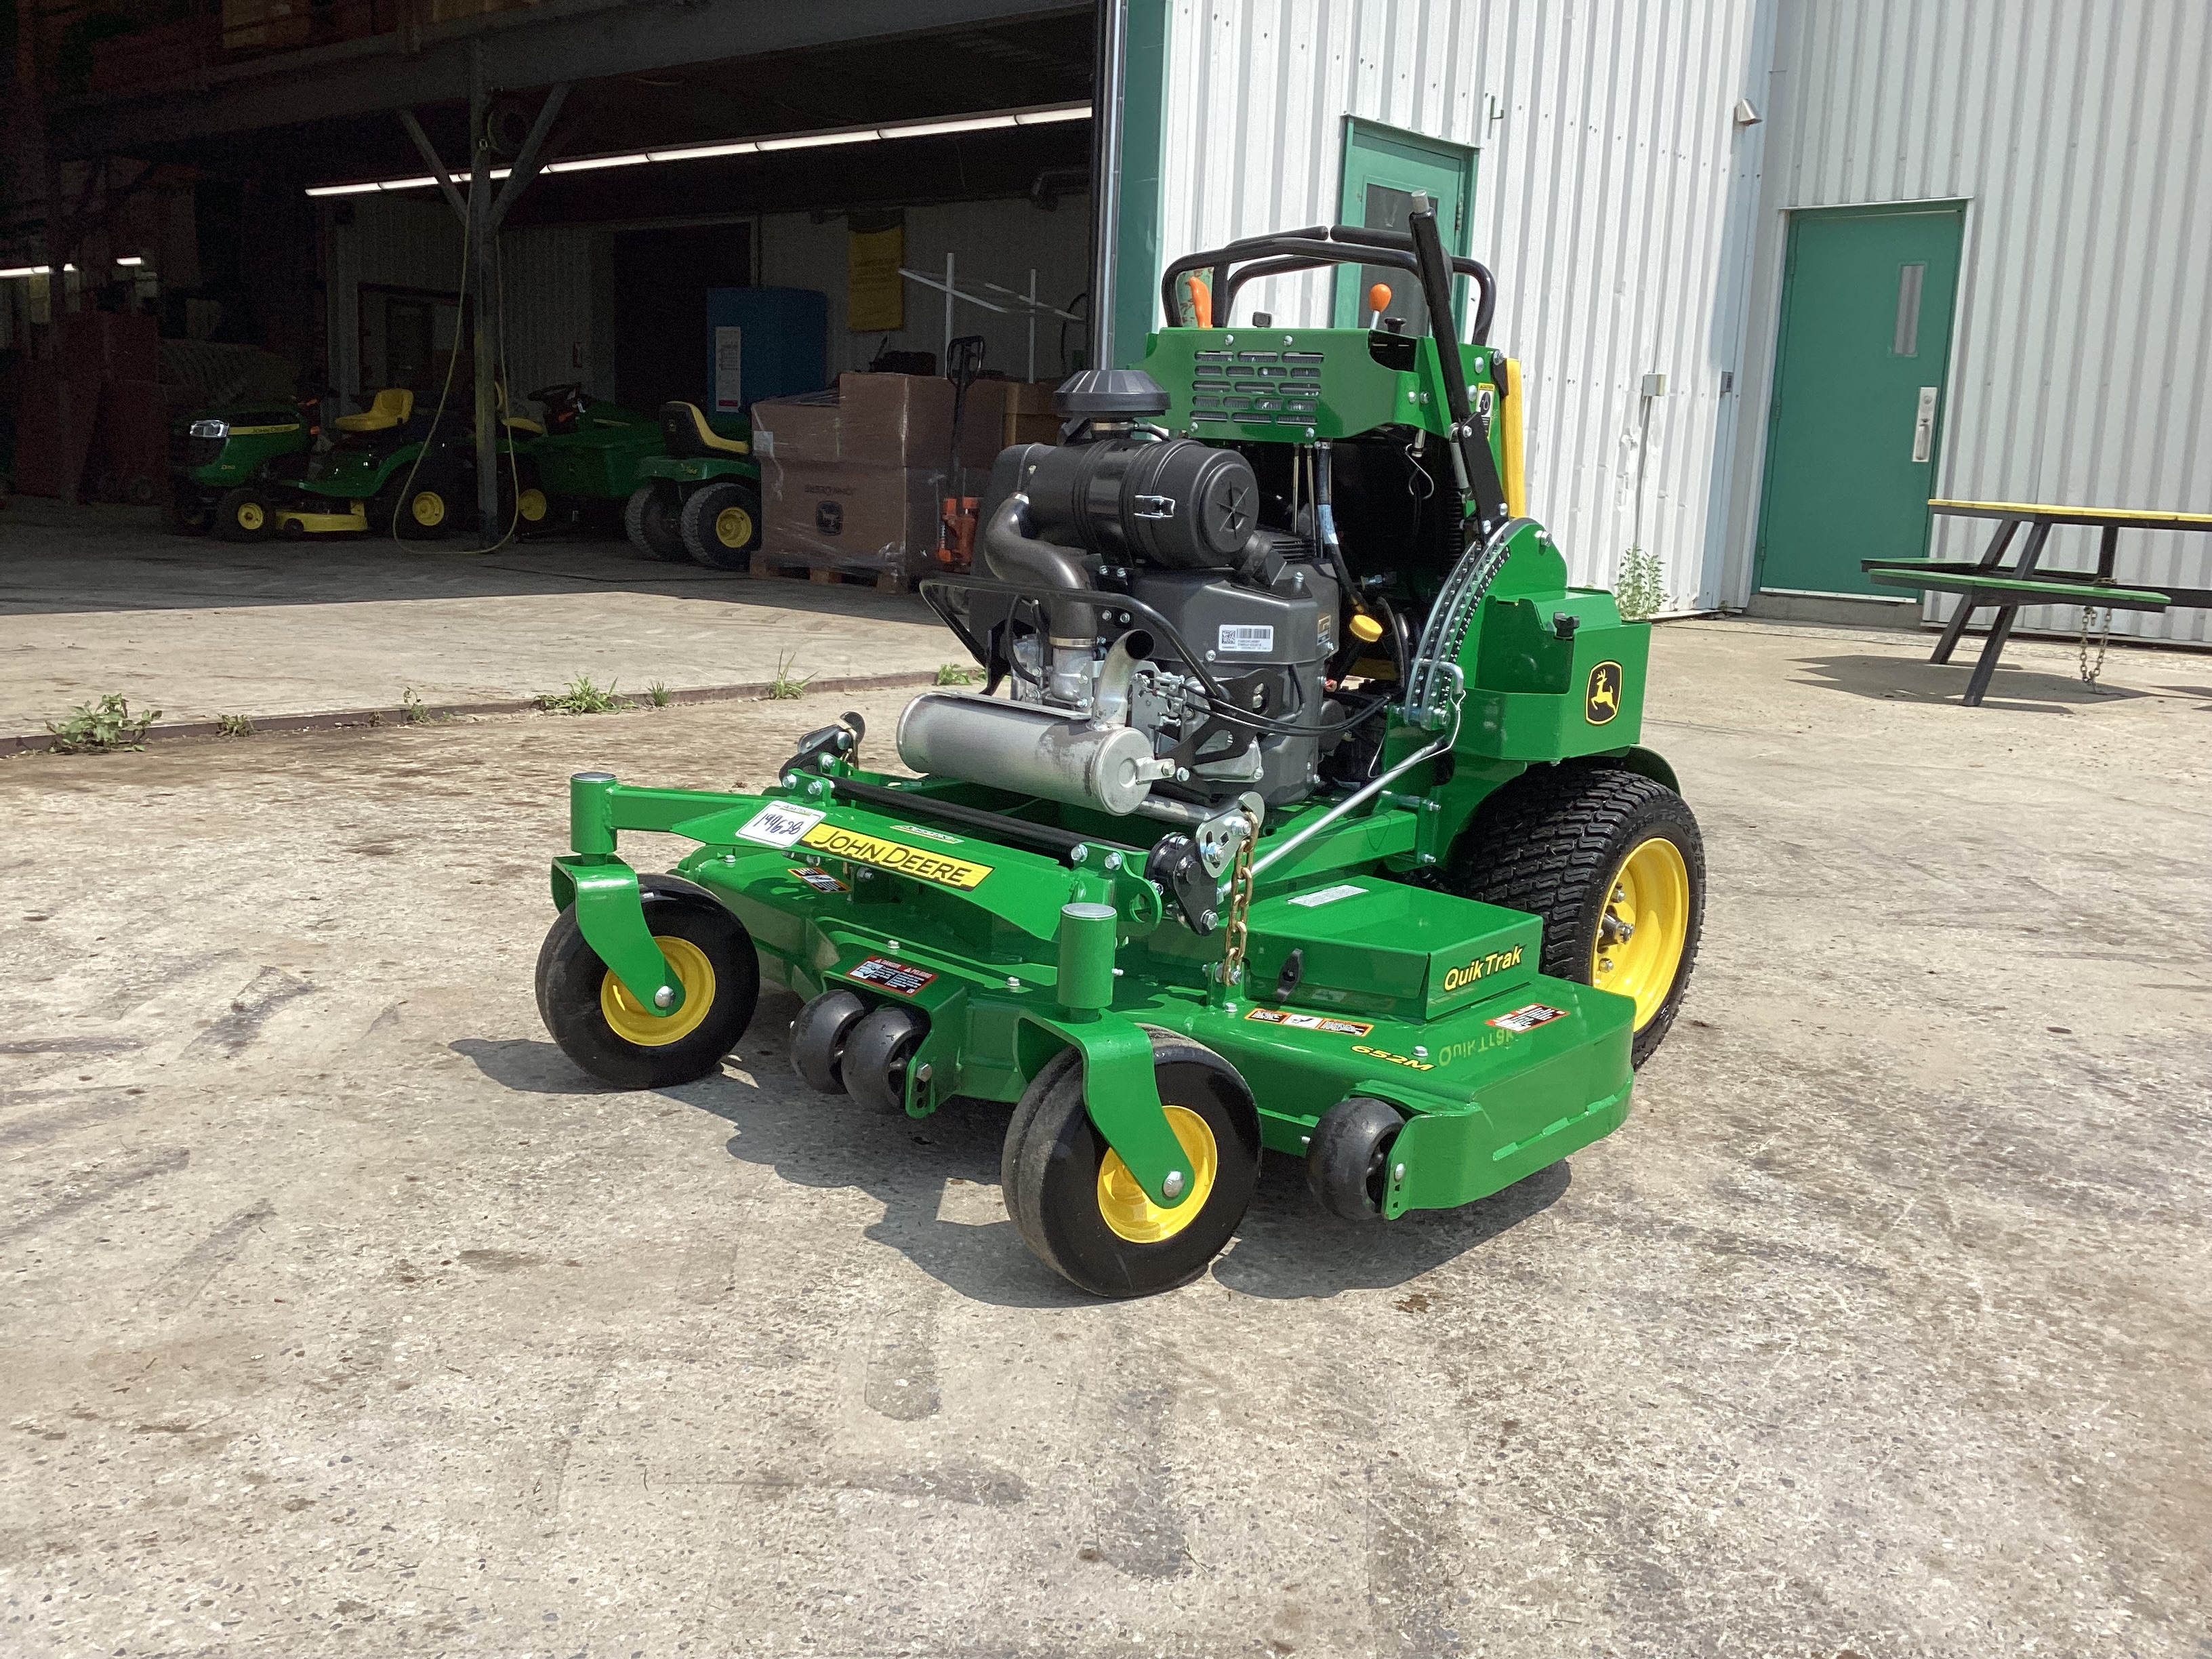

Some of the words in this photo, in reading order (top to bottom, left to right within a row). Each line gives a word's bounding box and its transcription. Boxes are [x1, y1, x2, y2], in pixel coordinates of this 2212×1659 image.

[813, 830, 885, 860] JOHN
[882, 846, 972, 883] DEERE
[1351, 1044, 1436, 1071] 652M
